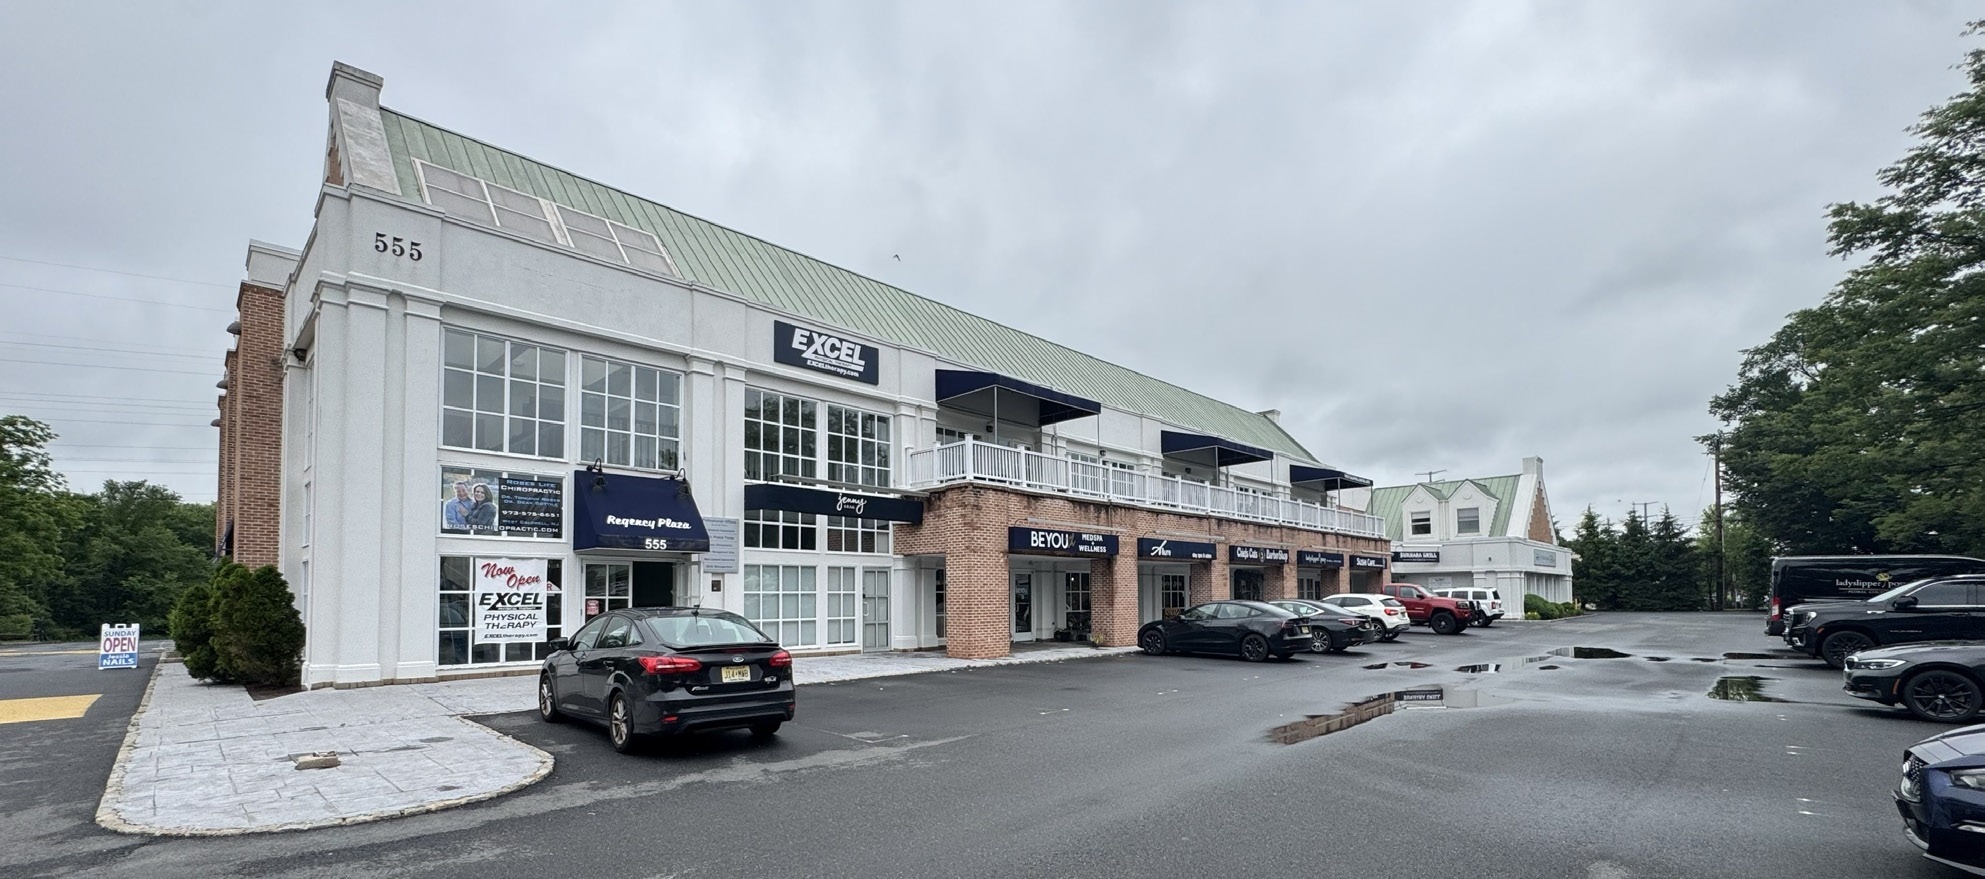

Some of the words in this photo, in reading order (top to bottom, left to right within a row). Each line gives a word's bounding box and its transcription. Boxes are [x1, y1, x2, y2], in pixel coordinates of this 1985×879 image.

[375, 232, 422, 261] 555
[792, 328, 865, 367] EXCEL
[607, 514, 655, 530] Regency
[657, 517, 692, 530] Plaza
[645, 539, 667, 550] 555
[1082, 533, 1103, 541] MEDSPA
[481, 562, 515, 578] Now
[507, 573, 541, 591] Open
[478, 592, 543, 610] EXCEL
[484, 613, 539, 621] PHYSICAL
[104, 630, 136, 638] SUNDAY
[104, 637, 136, 652] OPEN
